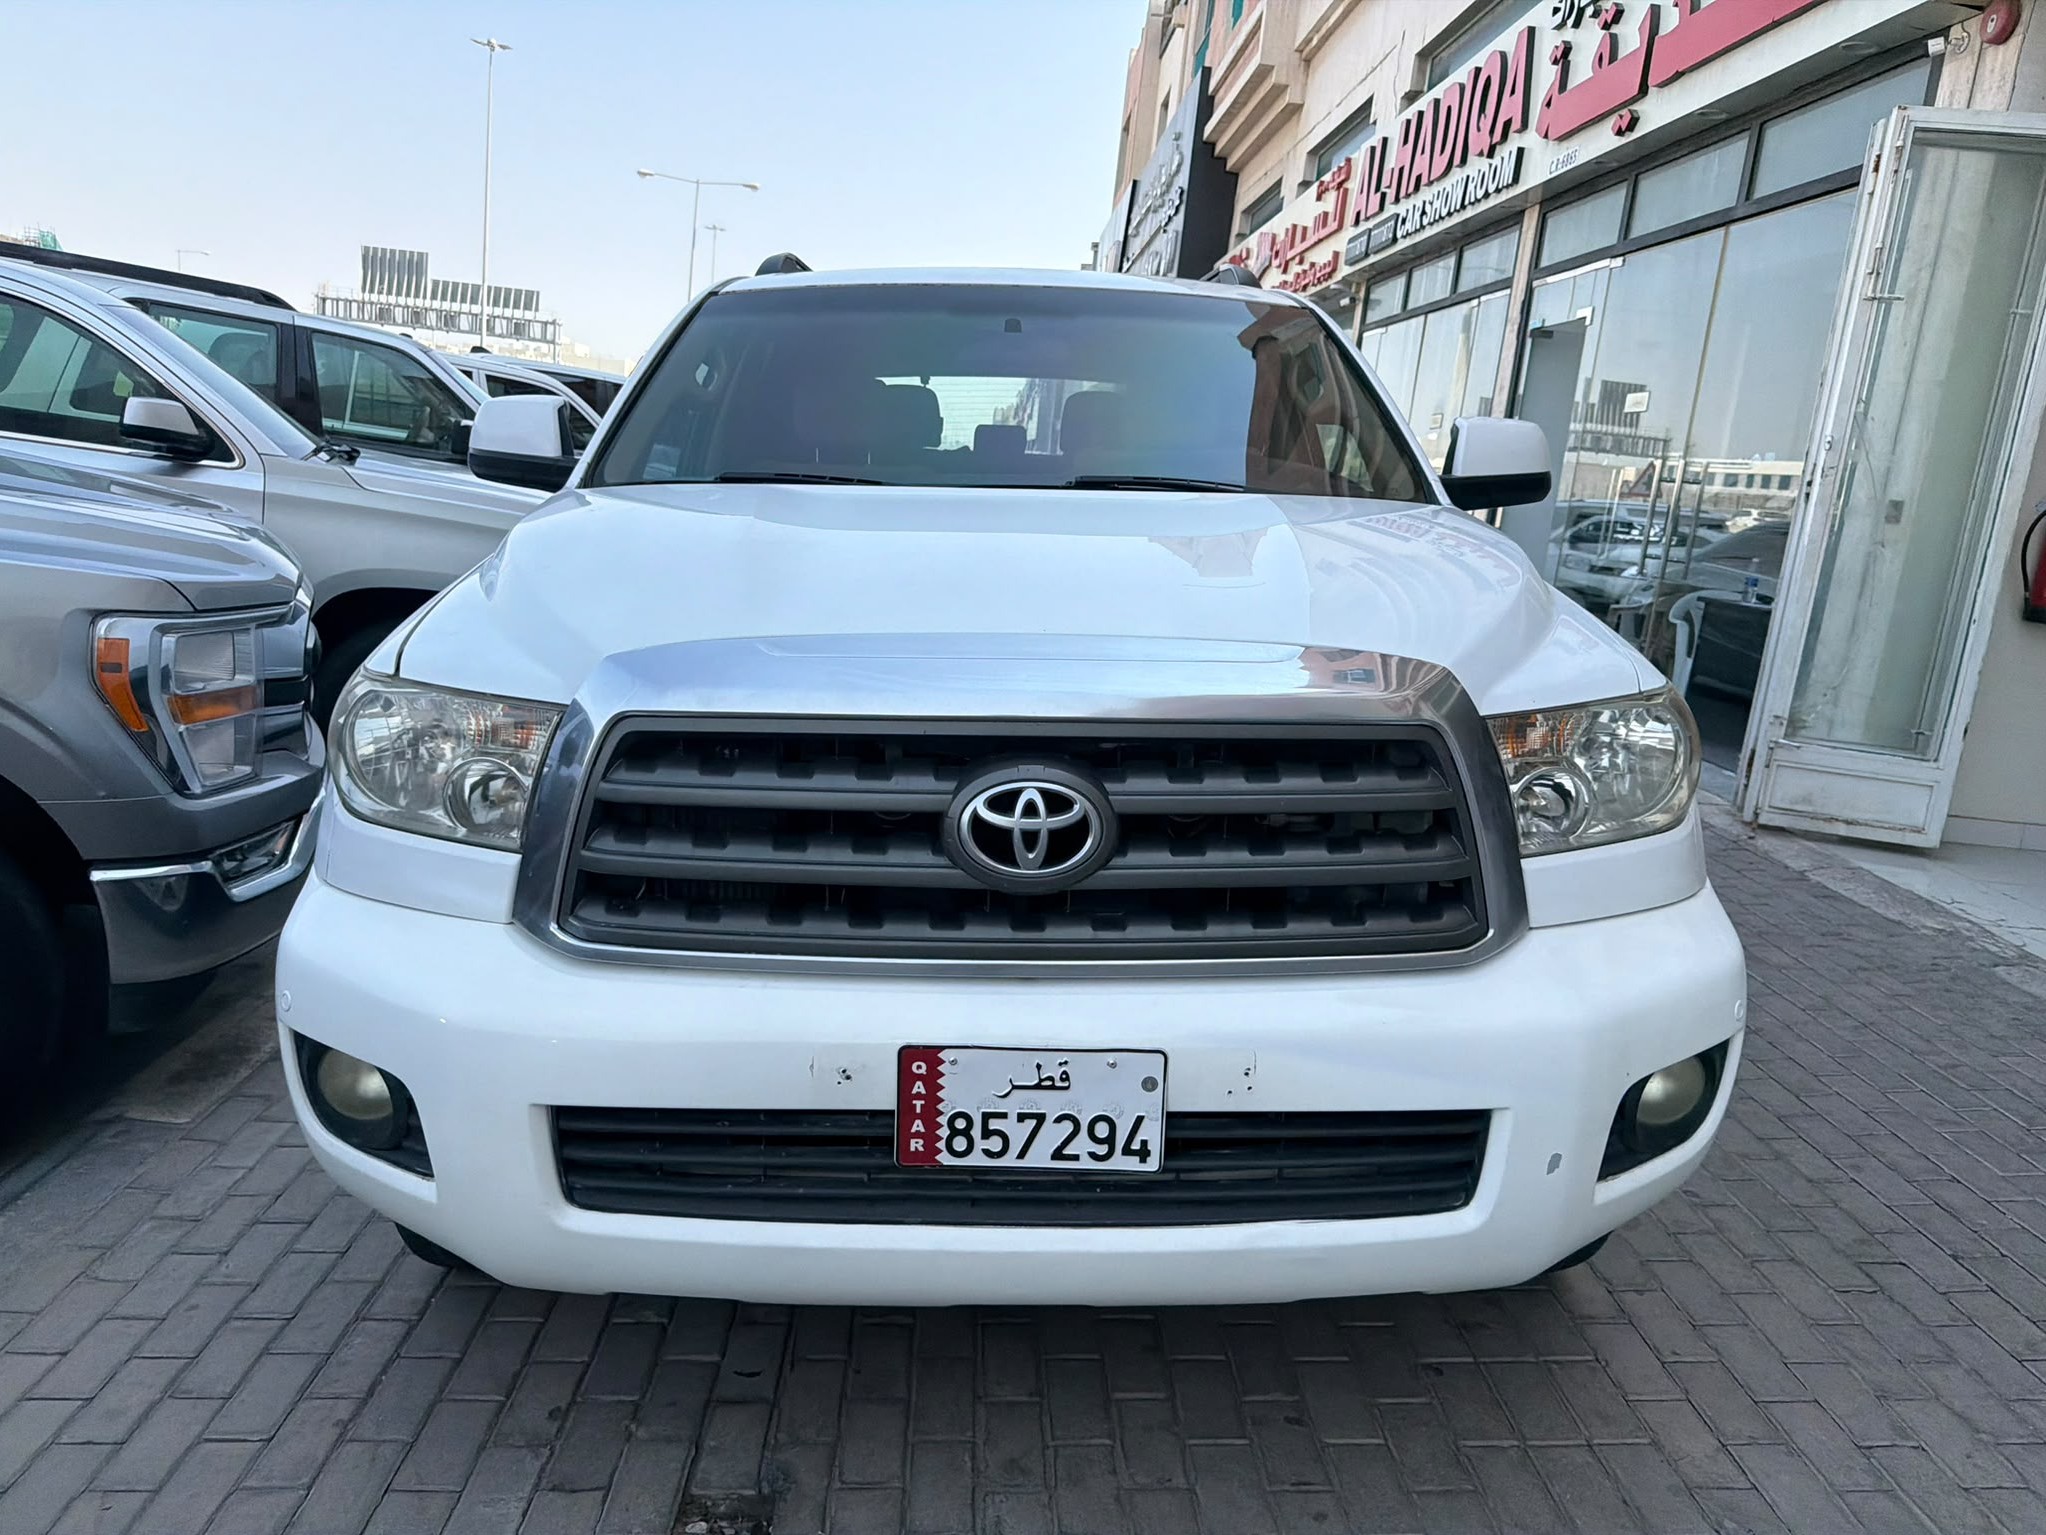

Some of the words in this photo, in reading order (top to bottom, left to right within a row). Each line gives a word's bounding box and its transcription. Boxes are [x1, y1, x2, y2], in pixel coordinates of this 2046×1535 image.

[1351, 26, 1535, 227] AL-HADIQA
[1396, 202, 1422, 240] CAR
[1422, 175, 1468, 227] SHOW
[1464, 147, 1525, 206] ROOM
[910, 1060, 927, 1152] QATAR
[993, 1058, 1072, 1098] قطر
[944, 1110, 1152, 1164] 857294
